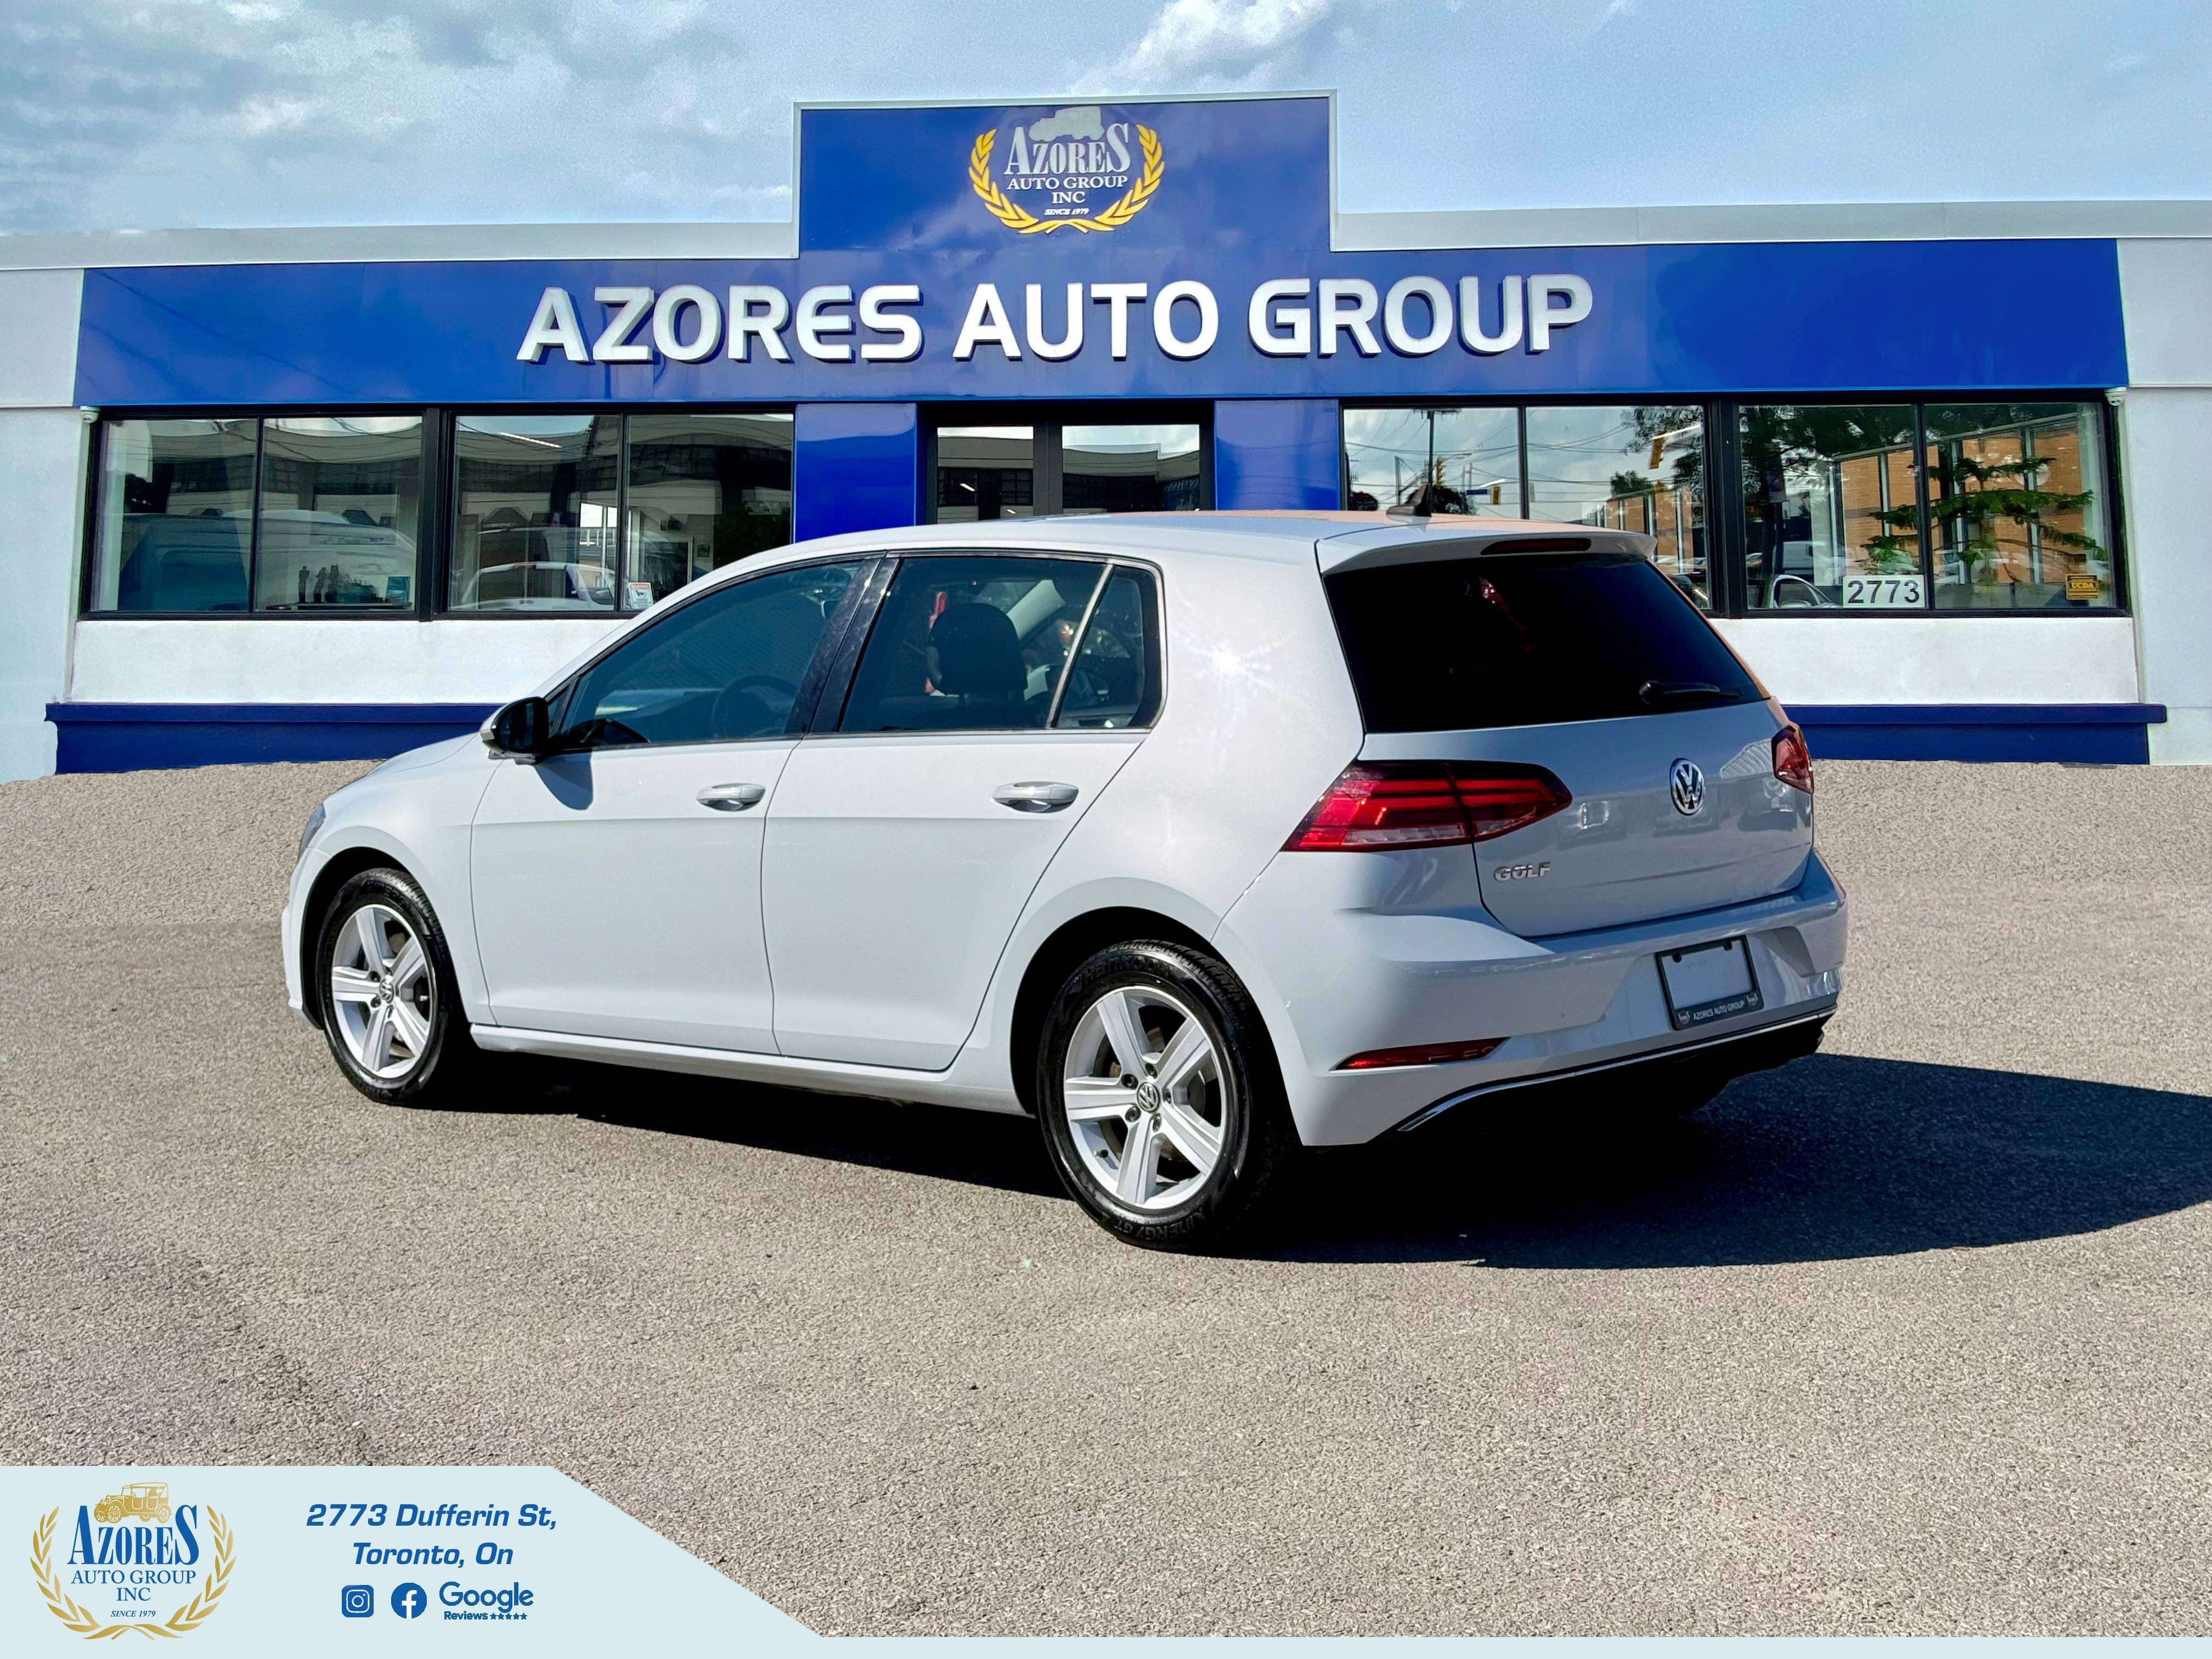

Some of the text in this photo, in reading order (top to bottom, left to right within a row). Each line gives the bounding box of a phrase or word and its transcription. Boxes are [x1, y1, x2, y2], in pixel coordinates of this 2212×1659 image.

[1003, 122, 1131, 175] AZORES
[1006, 175, 1128, 190] AUTO GROUP
[1051, 191, 1086, 204] INC
[1043, 207, 1090, 216] SINCE 1979
[516, 274, 1593, 363] AZORES AUTO GROUP
[1847, 579, 1920, 604] 2773
[1494, 862, 1551, 882] GOLF
[1693, 1000, 1745, 1021] AZORES AUTO GROUP
